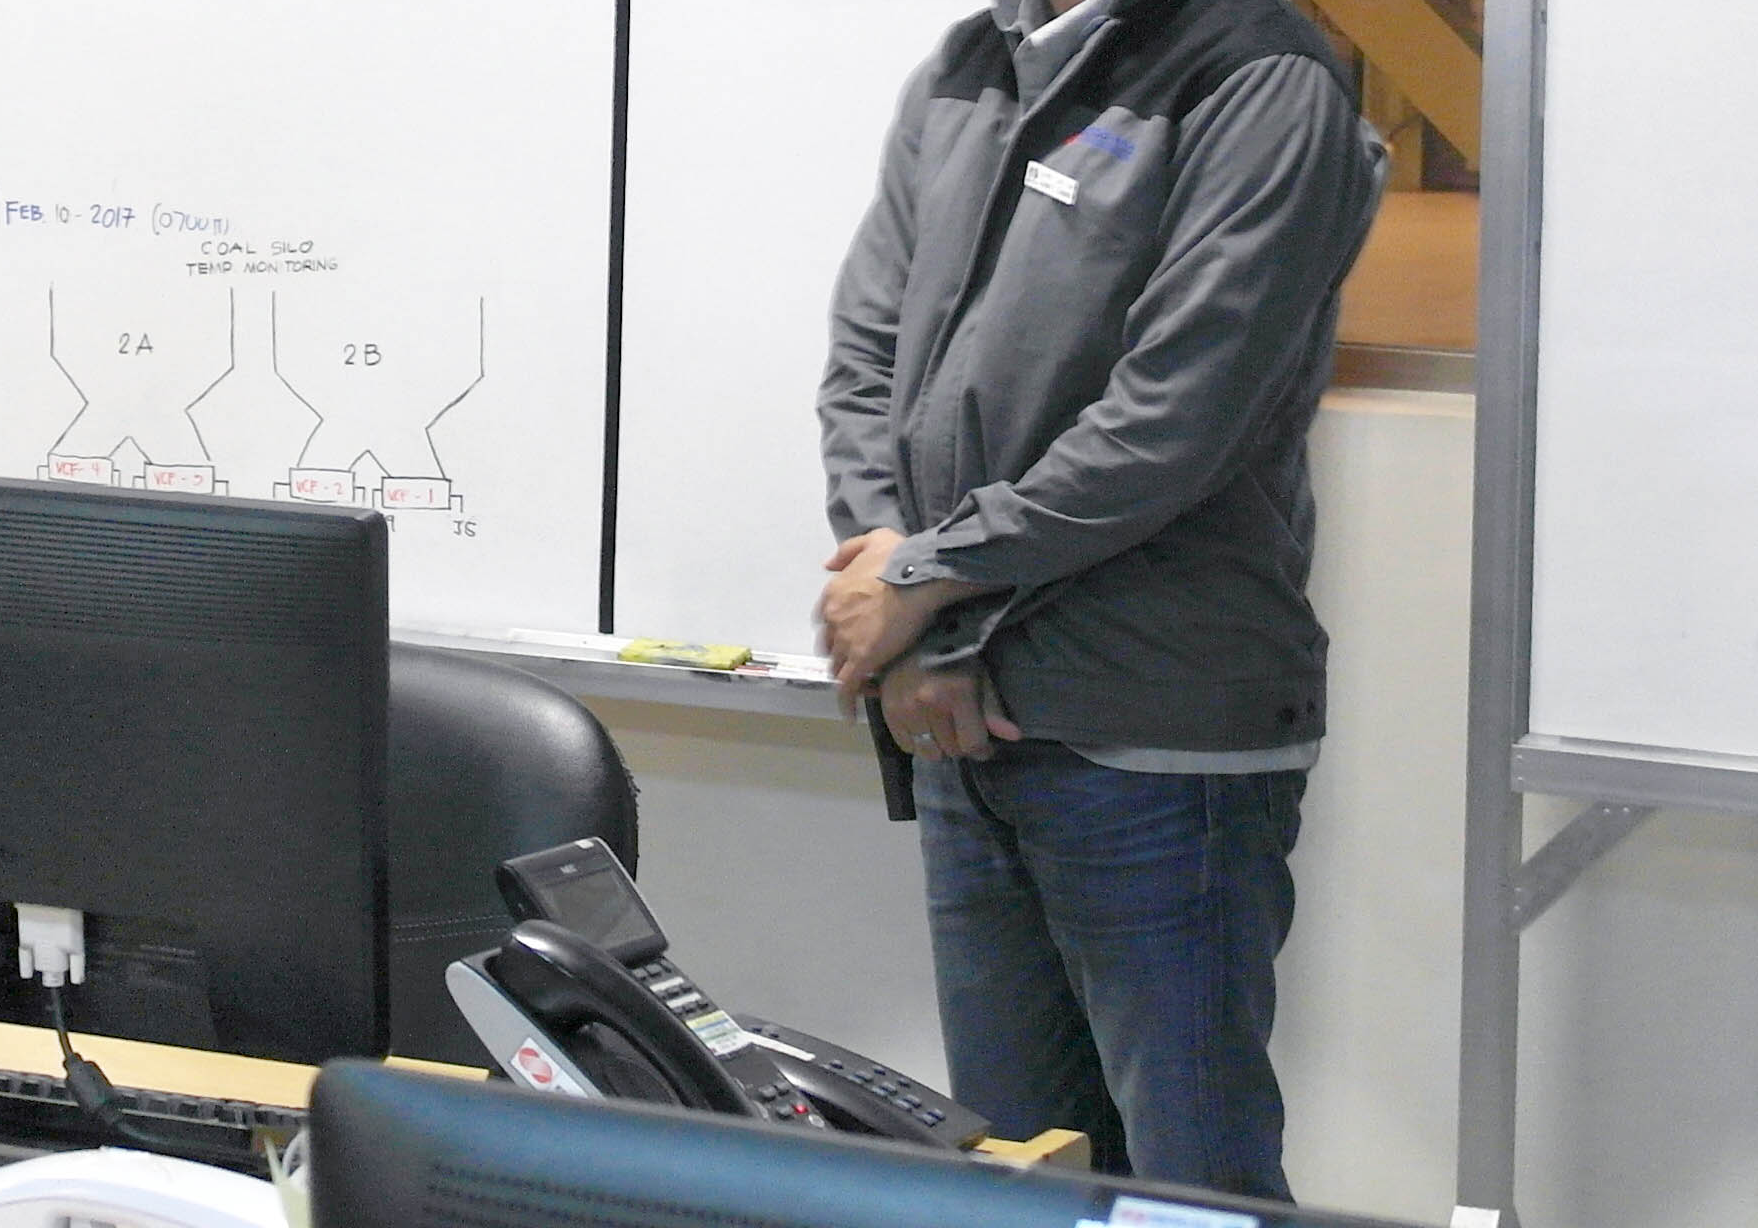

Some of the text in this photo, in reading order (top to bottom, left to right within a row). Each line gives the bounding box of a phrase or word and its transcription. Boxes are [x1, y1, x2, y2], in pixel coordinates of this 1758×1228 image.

[90, 204, 135, 228] 2017
[201, 240, 313, 256] COAL SILO
[185, 261, 233, 276] TEMP
